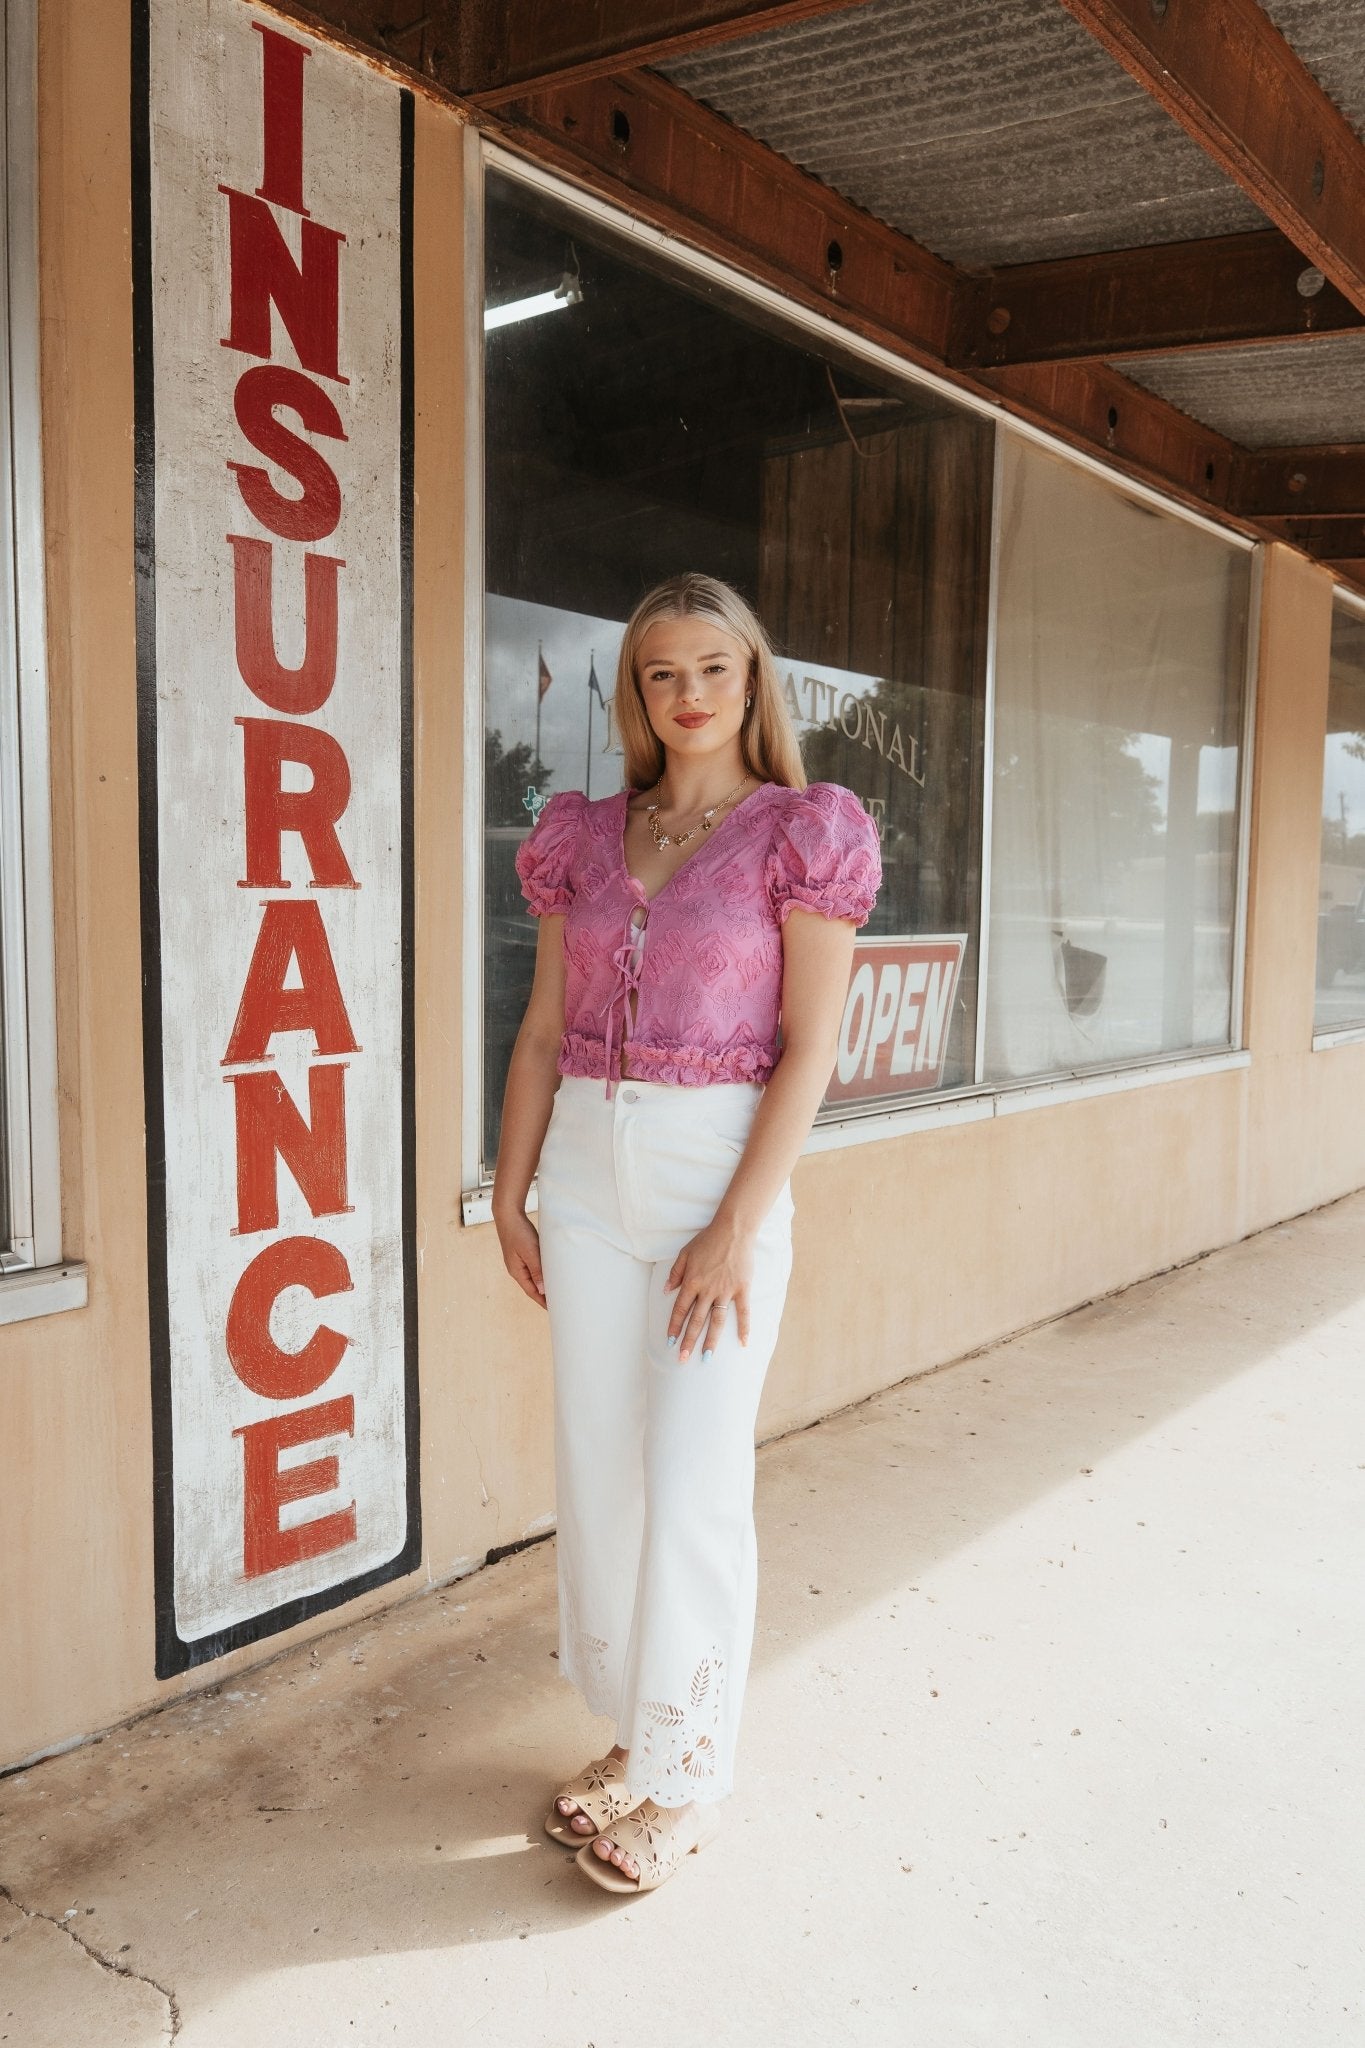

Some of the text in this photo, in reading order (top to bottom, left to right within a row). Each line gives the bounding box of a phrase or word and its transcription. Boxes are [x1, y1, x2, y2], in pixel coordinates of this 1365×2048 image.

[783, 672, 926, 788] ATIONAL
[218, 20, 363, 1580] INSURANCE
[837, 961, 955, 1085] OPEN
